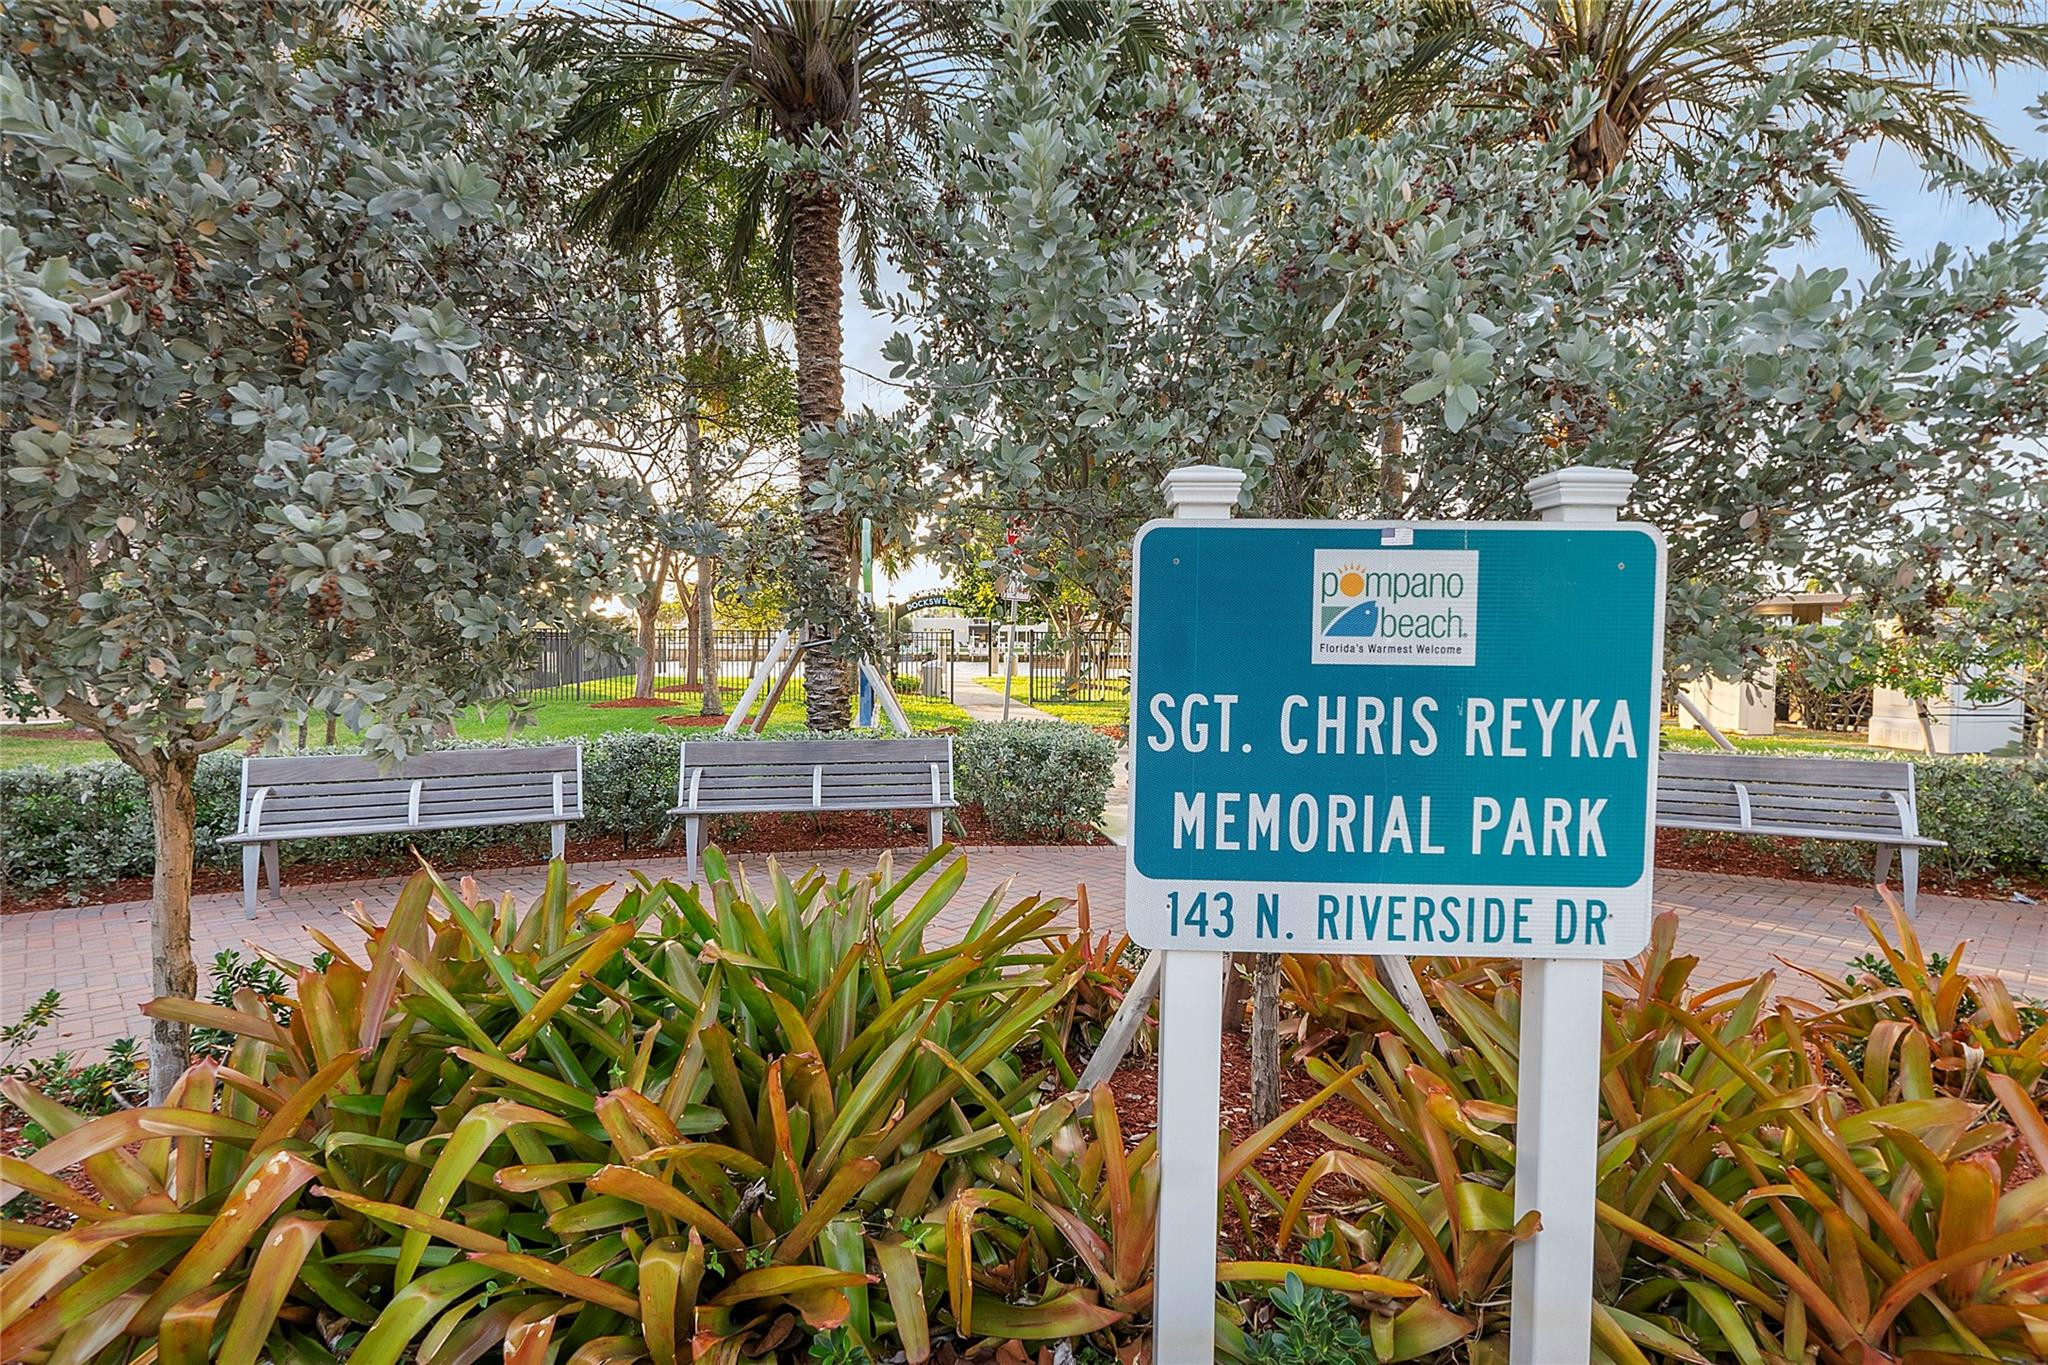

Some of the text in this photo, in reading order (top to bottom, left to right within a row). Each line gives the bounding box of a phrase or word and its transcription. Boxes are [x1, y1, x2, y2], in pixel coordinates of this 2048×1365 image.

[1319, 643, 1462, 656] Florida's Warmest Welcome
[1147, 692, 1638, 759] SGT. CHRIS REYKA
[1172, 791, 1608, 858] MEMORIAL PARK
[1167, 891, 1607, 946] 143 N. RIVERSIDE DR
